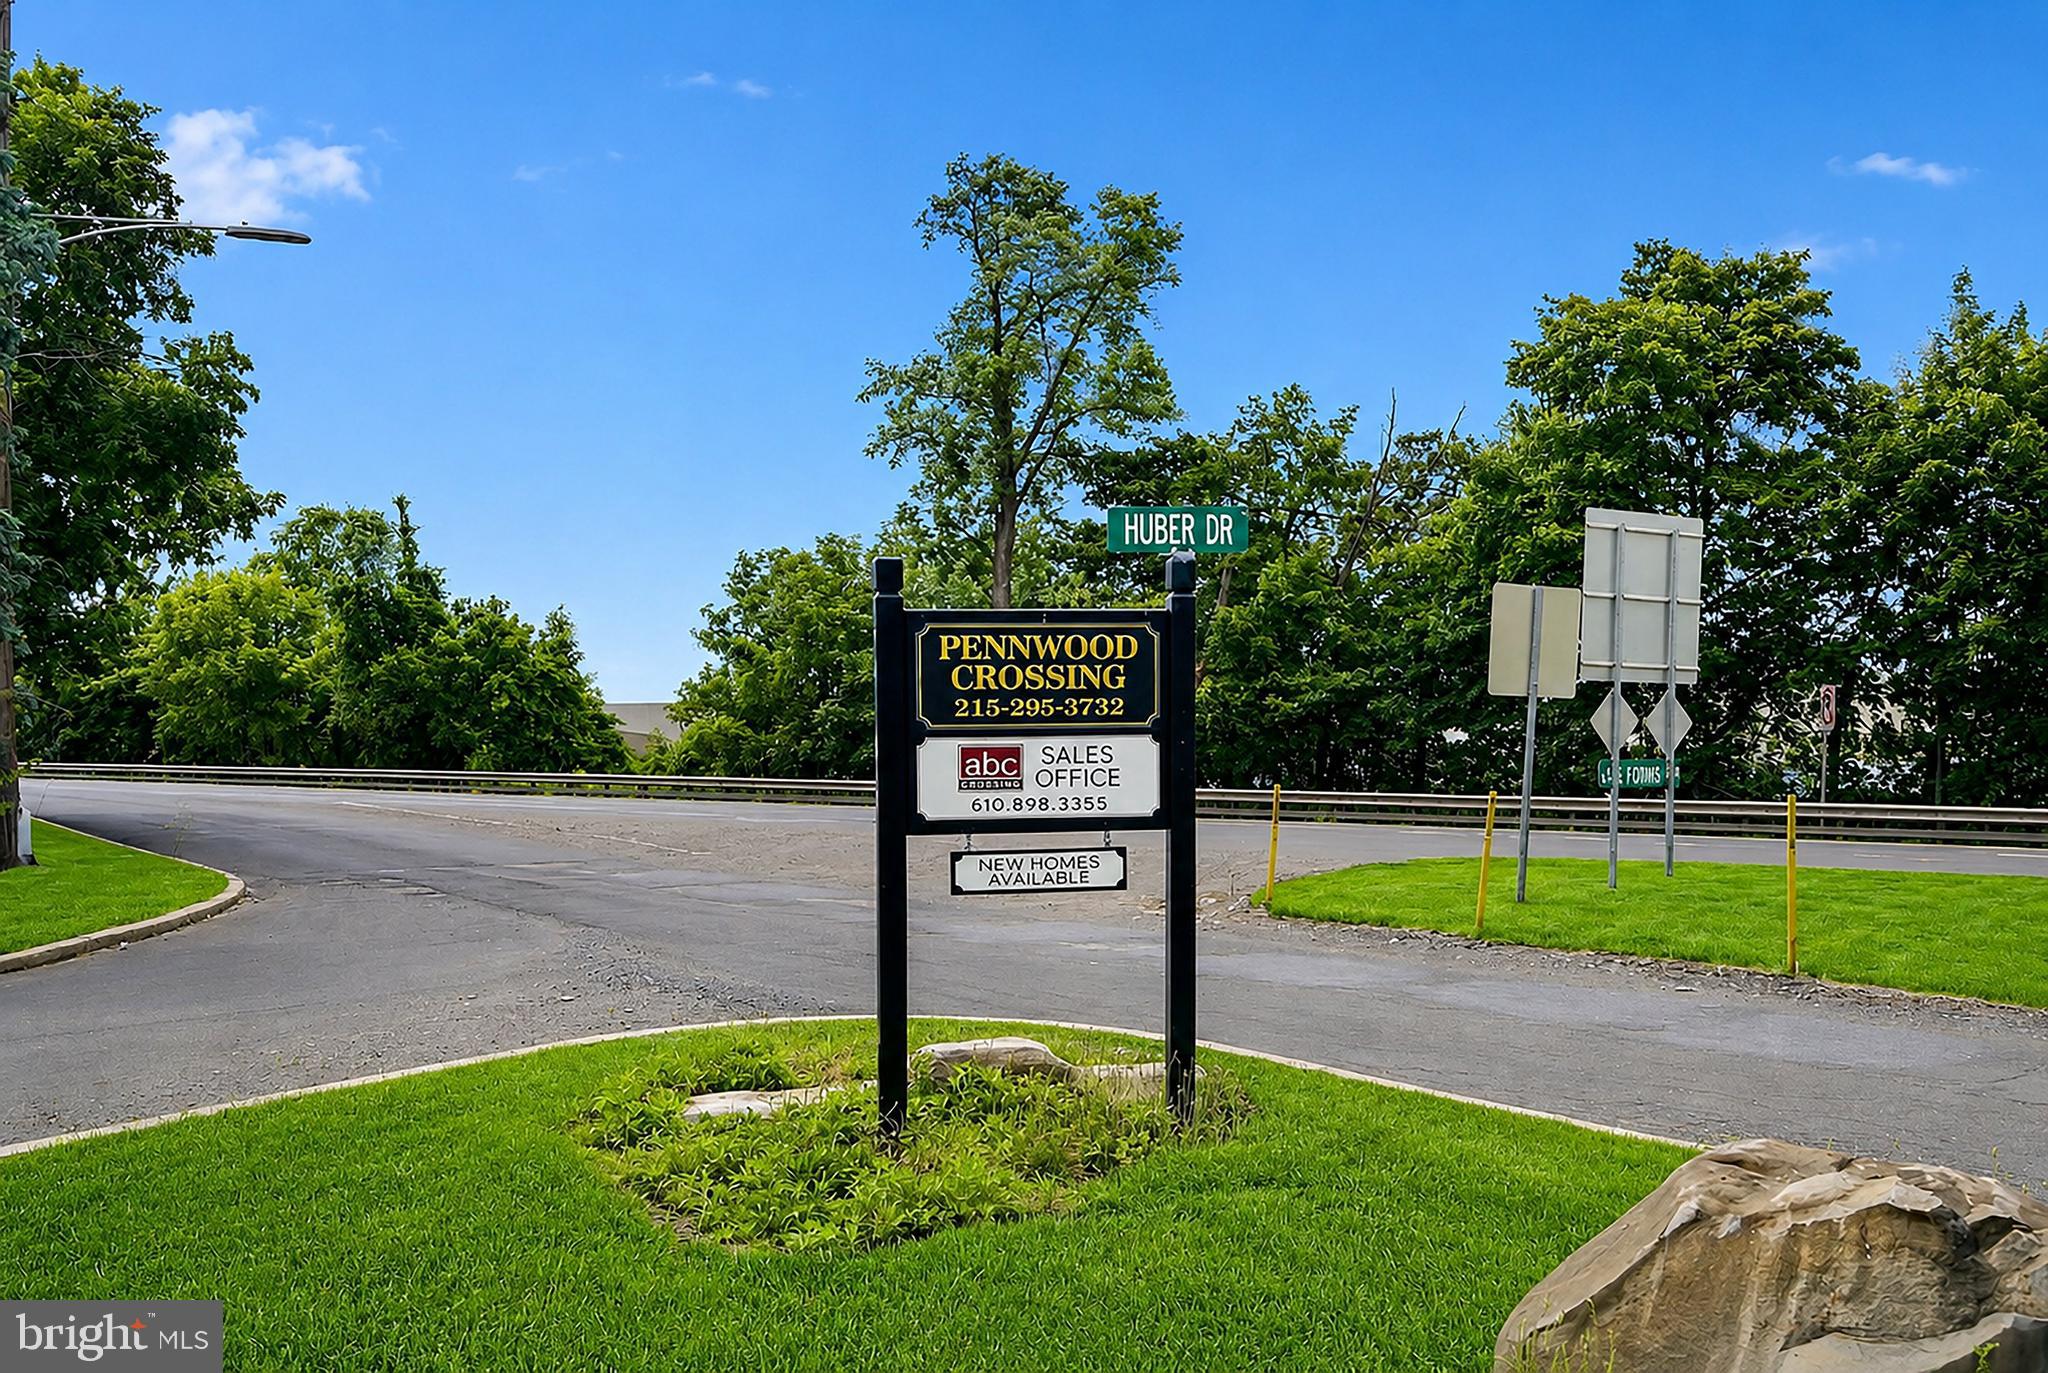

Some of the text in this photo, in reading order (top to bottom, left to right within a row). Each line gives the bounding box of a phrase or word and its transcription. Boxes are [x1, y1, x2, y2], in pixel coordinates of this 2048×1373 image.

[1124, 512, 1233, 546] HUBER DR
[938, 634, 1138, 661] PENNWOOD
[951, 664, 1126, 690] CROSSING
[954, 697, 1124, 717] 215-295-3732
[965, 751, 1018, 776] abc
[1041, 745, 1113, 765] SALES
[1035, 768, 1121, 788] OFFICE
[971, 797, 1108, 812] 610.898.3355
[978, 855, 1100, 872] NEW HOMES
[987, 871, 1090, 887] AVAILABLE
